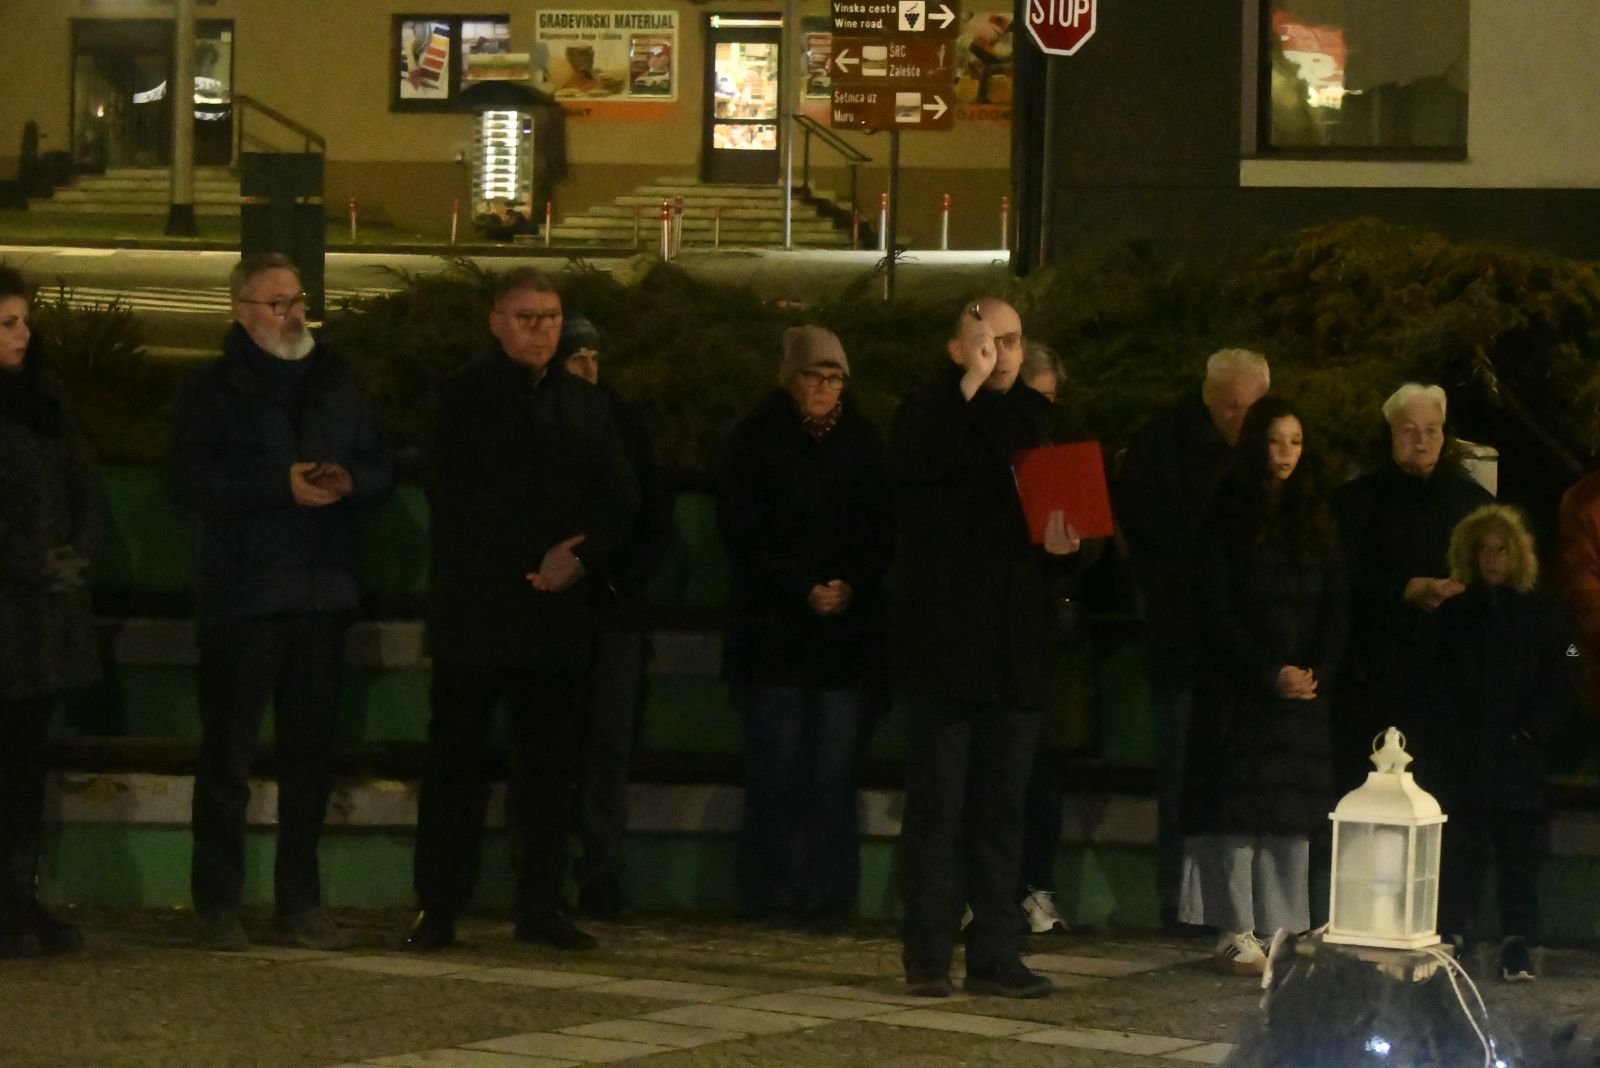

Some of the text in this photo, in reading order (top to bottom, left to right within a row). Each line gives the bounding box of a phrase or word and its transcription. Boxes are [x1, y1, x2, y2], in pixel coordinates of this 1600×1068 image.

[834, 2, 897, 14] Vinska cesta
[1031, 0, 1090, 28] STOP
[614, 14, 675, 29] MATERIJAL
[834, 18, 883, 29] Wine road
[867, 93, 878, 104] uz
[834, 109, 854, 122] Muru
